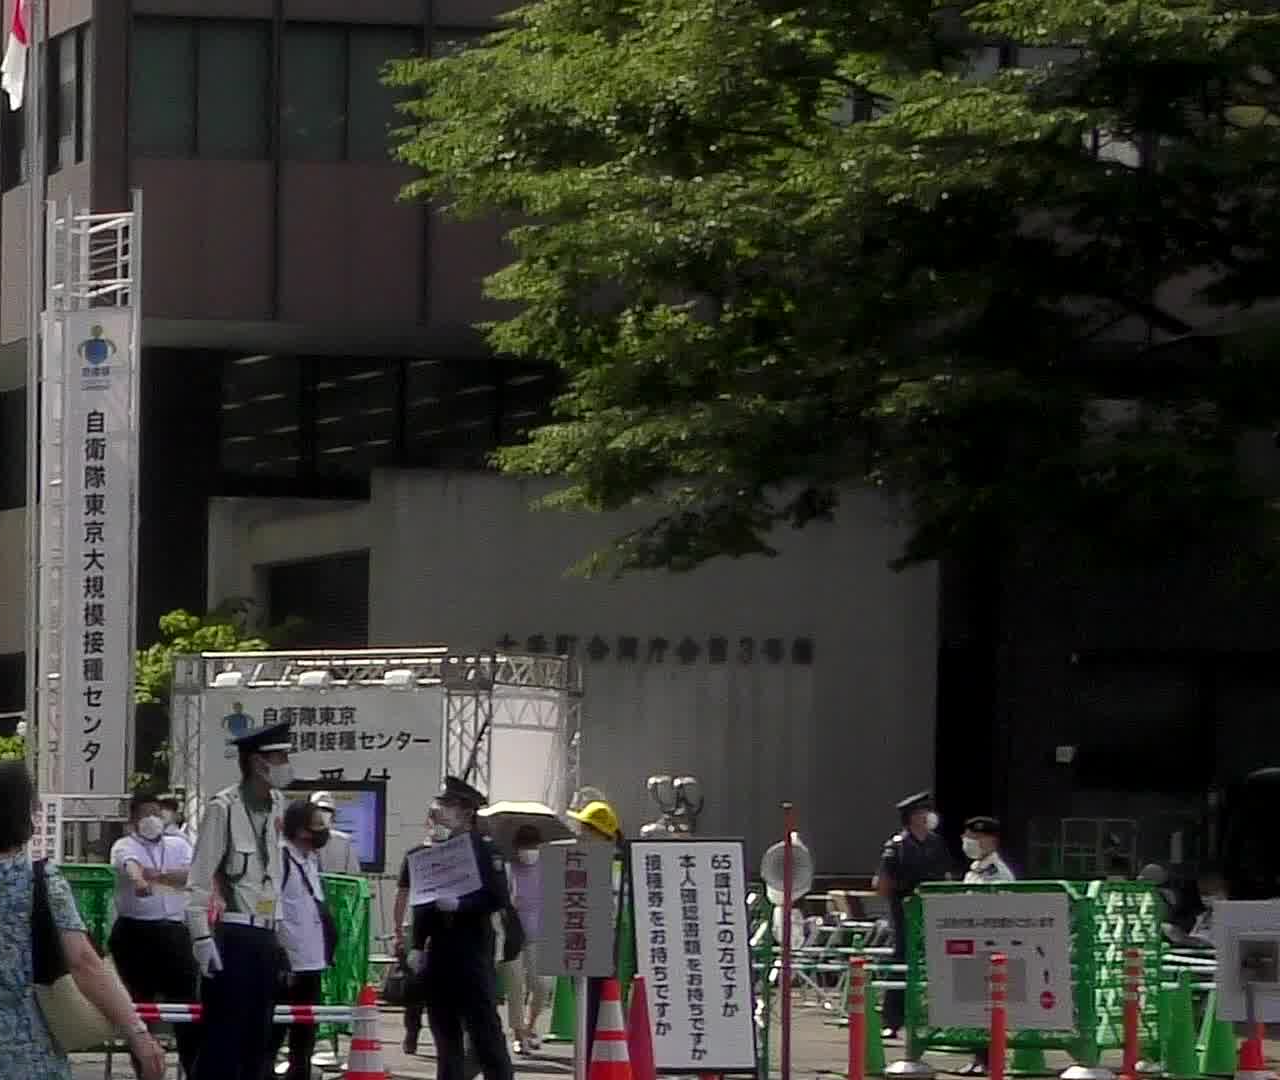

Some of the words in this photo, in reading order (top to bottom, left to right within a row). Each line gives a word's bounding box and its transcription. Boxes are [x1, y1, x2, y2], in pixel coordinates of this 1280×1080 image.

[81, 410, 107, 791] 自衛隊東京大規模接種センター
[263, 706, 356, 727] 自衛隊東京
[290, 730, 431, 751] 模接種センター
[645, 854, 672, 1036] 接種券をお持ちですか
[679, 854, 707, 1061] 本人確認書類をお持ちですか
[711, 854, 739, 1018] 65歳以上の方ですか
